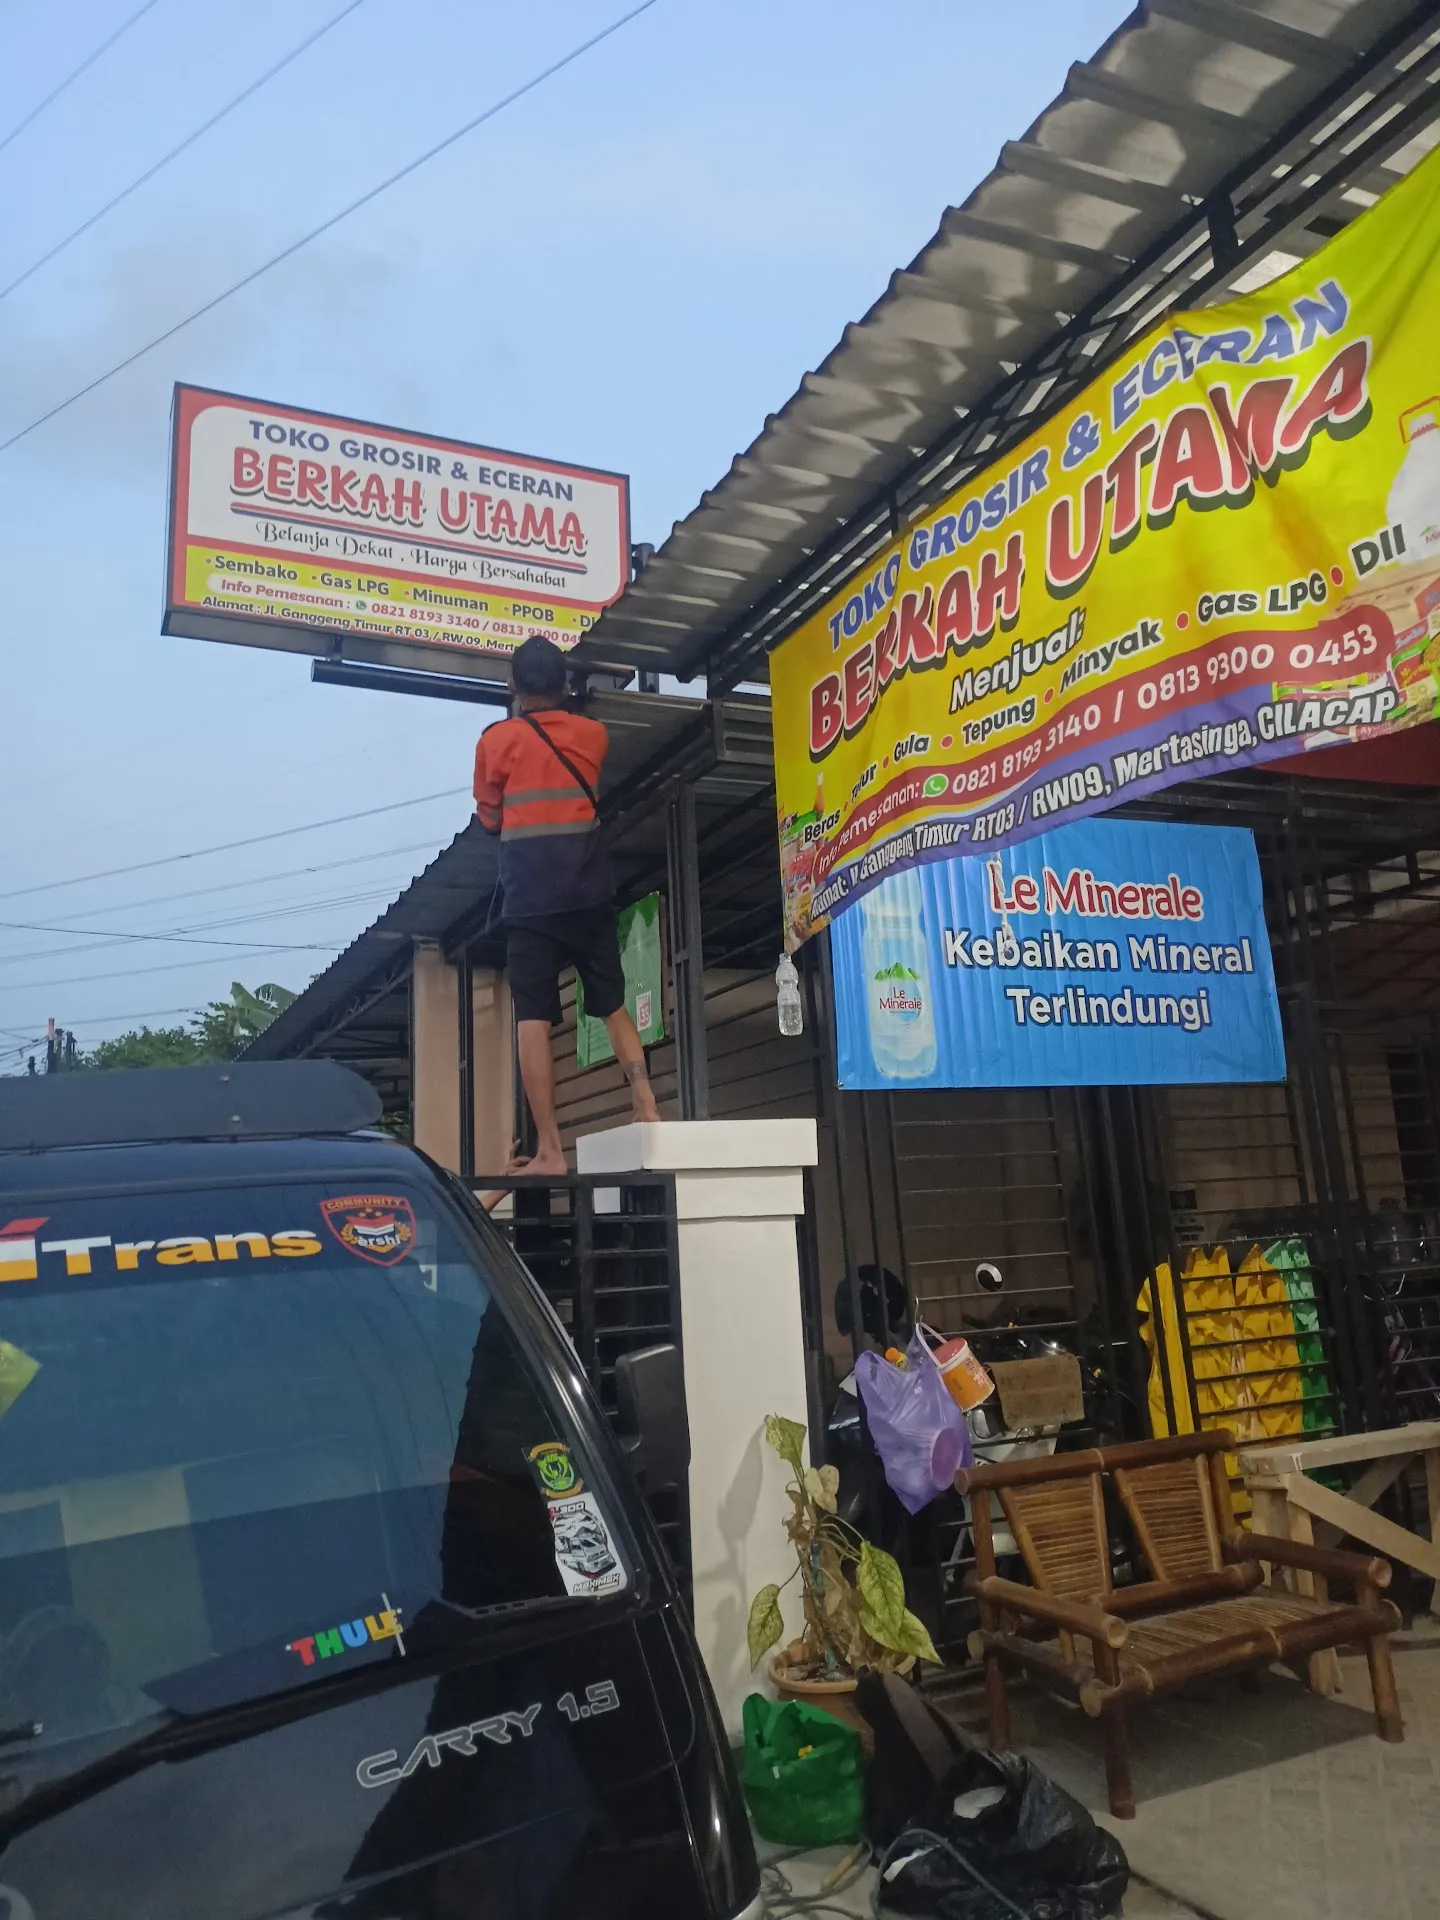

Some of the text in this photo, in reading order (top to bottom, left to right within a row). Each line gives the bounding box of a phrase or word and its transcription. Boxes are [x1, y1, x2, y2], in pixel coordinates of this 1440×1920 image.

[249, 420, 573, 501] TOKO GROSIR & ECERAN
[829, 281, 1348, 651] TOKO GROSIR & ECERAN
[233, 447, 588, 557] BERKAH UTAMA
[256, 521, 330, 551] Belanja
[336, 535, 393, 559] Dekat
[411, 550, 467, 576] Harga
[473, 560, 567, 589] Bersahabat
[810, 338, 1373, 762] BERKAH UTAMA
[202, 596, 254, 613] Alamat
[280, 607, 351, 629] Ganggeng
[354, 618, 391, 633] Timur
[395, 625, 411, 636] RT
[414, 628, 429, 639] 03
[442, 633, 463, 644] RW
[214, 556, 299, 581] Sembako
[320, 573, 352, 590] Gas
[357, 578, 389, 596] LPG
[413, 588, 489, 612] Minuman
[512, 604, 555, 622] PPOB
[221, 579, 252, 594] Info
[255, 585, 344, 608] Pemesanan
[371, 603, 405, 618] 0821
[409, 610, 442, 623] 8193
[447, 616, 480, 629] 3140
[492, 622, 524, 637] 0813
[949, 607, 1086, 716] Menjual:
[804, 810, 841, 843] Beras
[894, 735, 930, 762] Gula
[962, 696, 1036, 745] Tepung
[1060, 621, 1162, 693] Minyak
[1198, 593, 1258, 622] Gas
[1268, 572, 1327, 612] LPG
[818, 845, 838, 875] Info
[837, 782, 921, 851] Pemesanan:
[952, 761, 997, 794] 0821
[1002, 739, 1042, 779] 8193
[1045, 704, 1101, 752] 3140
[1113, 691, 1124, 723] /
[1137, 665, 1200, 710] 0813
[1207, 643, 1275, 685] 9300
[1289, 624, 1378, 668] 0453
[860, 834, 915, 880] Ganggeng
[914, 822, 969, 850] Timur
[972, 803, 1014, 841] RT03
[1032, 766, 1112, 818] RW09,
[1114, 718, 1258, 787] Mertasinga,
[1257, 690, 1397, 741] CILACAP
[989, 863, 1203, 919] Le Minerale
[945, 929, 1254, 972] Kebaikan Mineral
[879, 997, 922, 1010] Minerale
[893, 986, 905, 999] Le
[1006, 988, 1210, 1031] Terlindungi
[326, 1198, 401, 1210] COMMUNITY
[291, 1608, 404, 1667] THULE
[355, 1679, 621, 1789] CARRY 1.5
